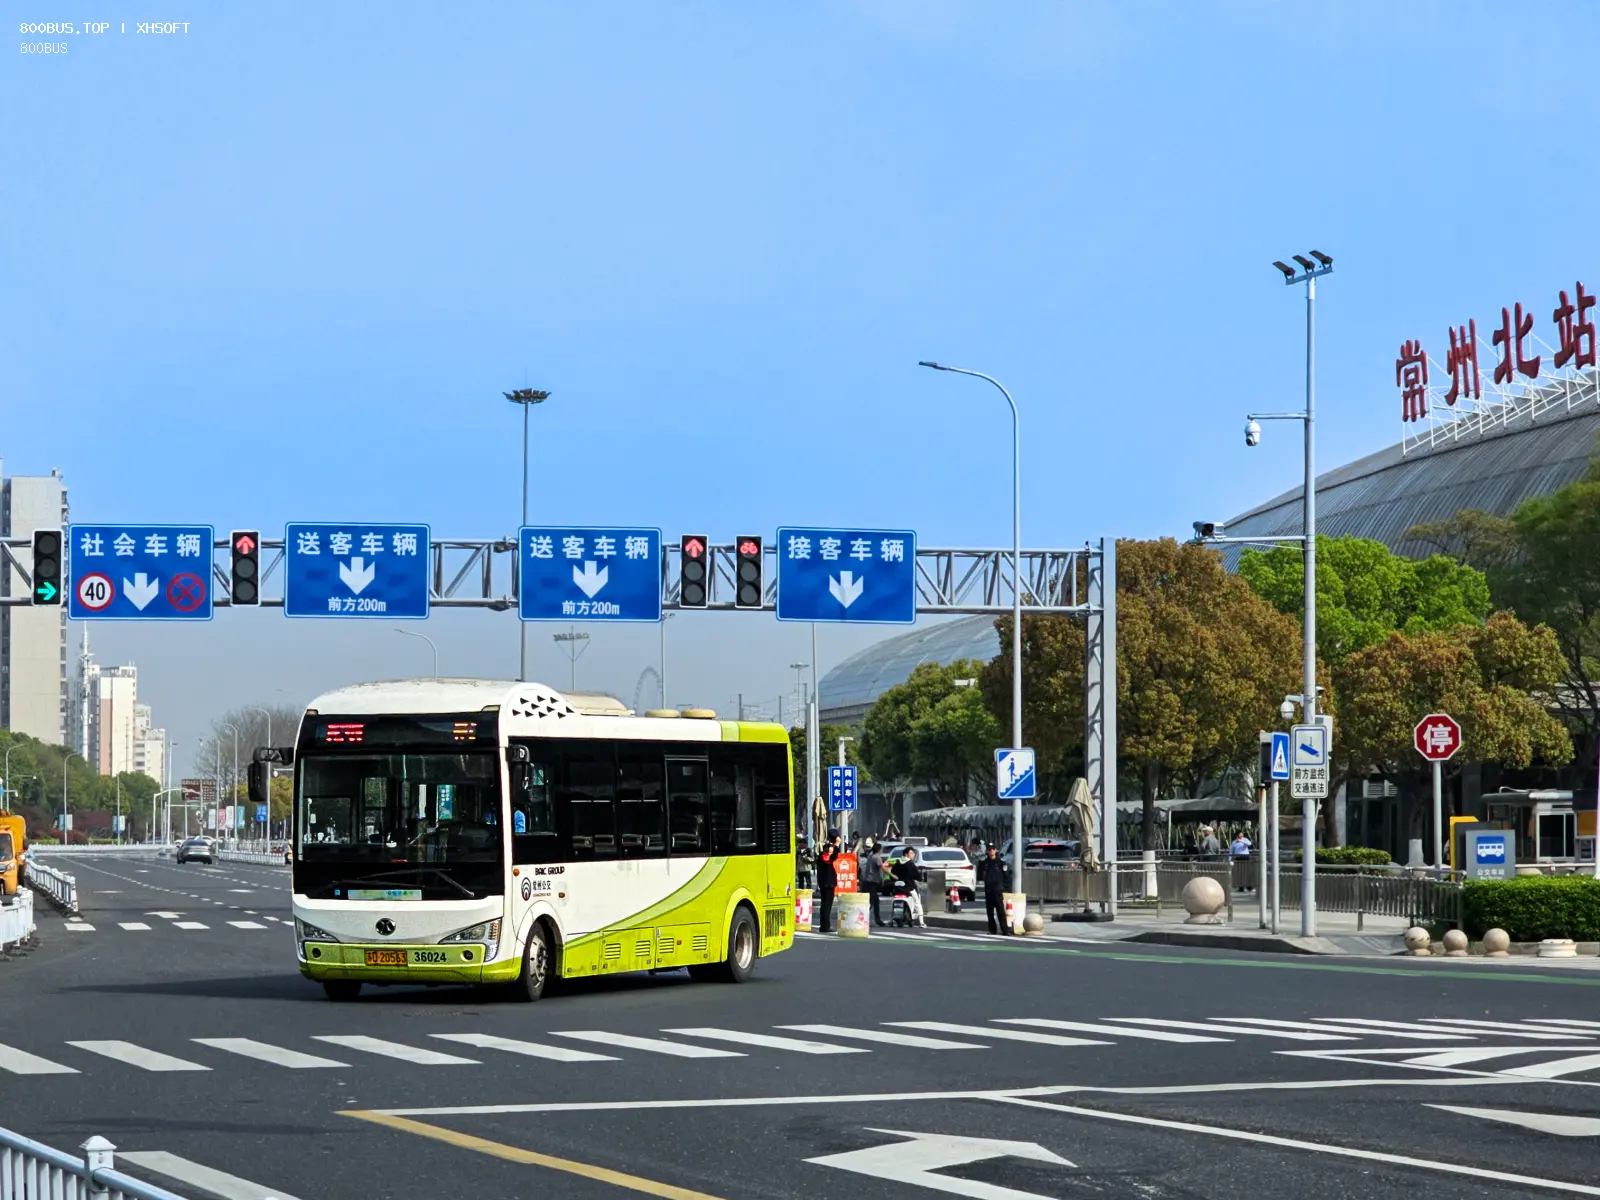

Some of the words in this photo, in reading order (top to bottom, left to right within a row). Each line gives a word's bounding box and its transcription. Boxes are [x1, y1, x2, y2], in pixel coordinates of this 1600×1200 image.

[1396, 280, 1596, 423] 常州北站
[80, 532, 202, 558] 社会车辆
[296, 531, 419, 558] 送客车辆
[529, 535, 650, 561] 送客车辆
[787, 535, 905, 563] 接客车辆
[85, 581, 107, 601] 40
[327, 596, 387, 613] 前方200m
[561, 600, 620, 616] 前方200m
[1423, 723, 1453, 753] 停
[832, 769, 842, 797] 网约车
[844, 769, 853, 797] 网约车
[1294, 768, 1325, 780] 前方监控
[1294, 783, 1325, 794] 交通违法
[414, 951, 447, 963] 36024
